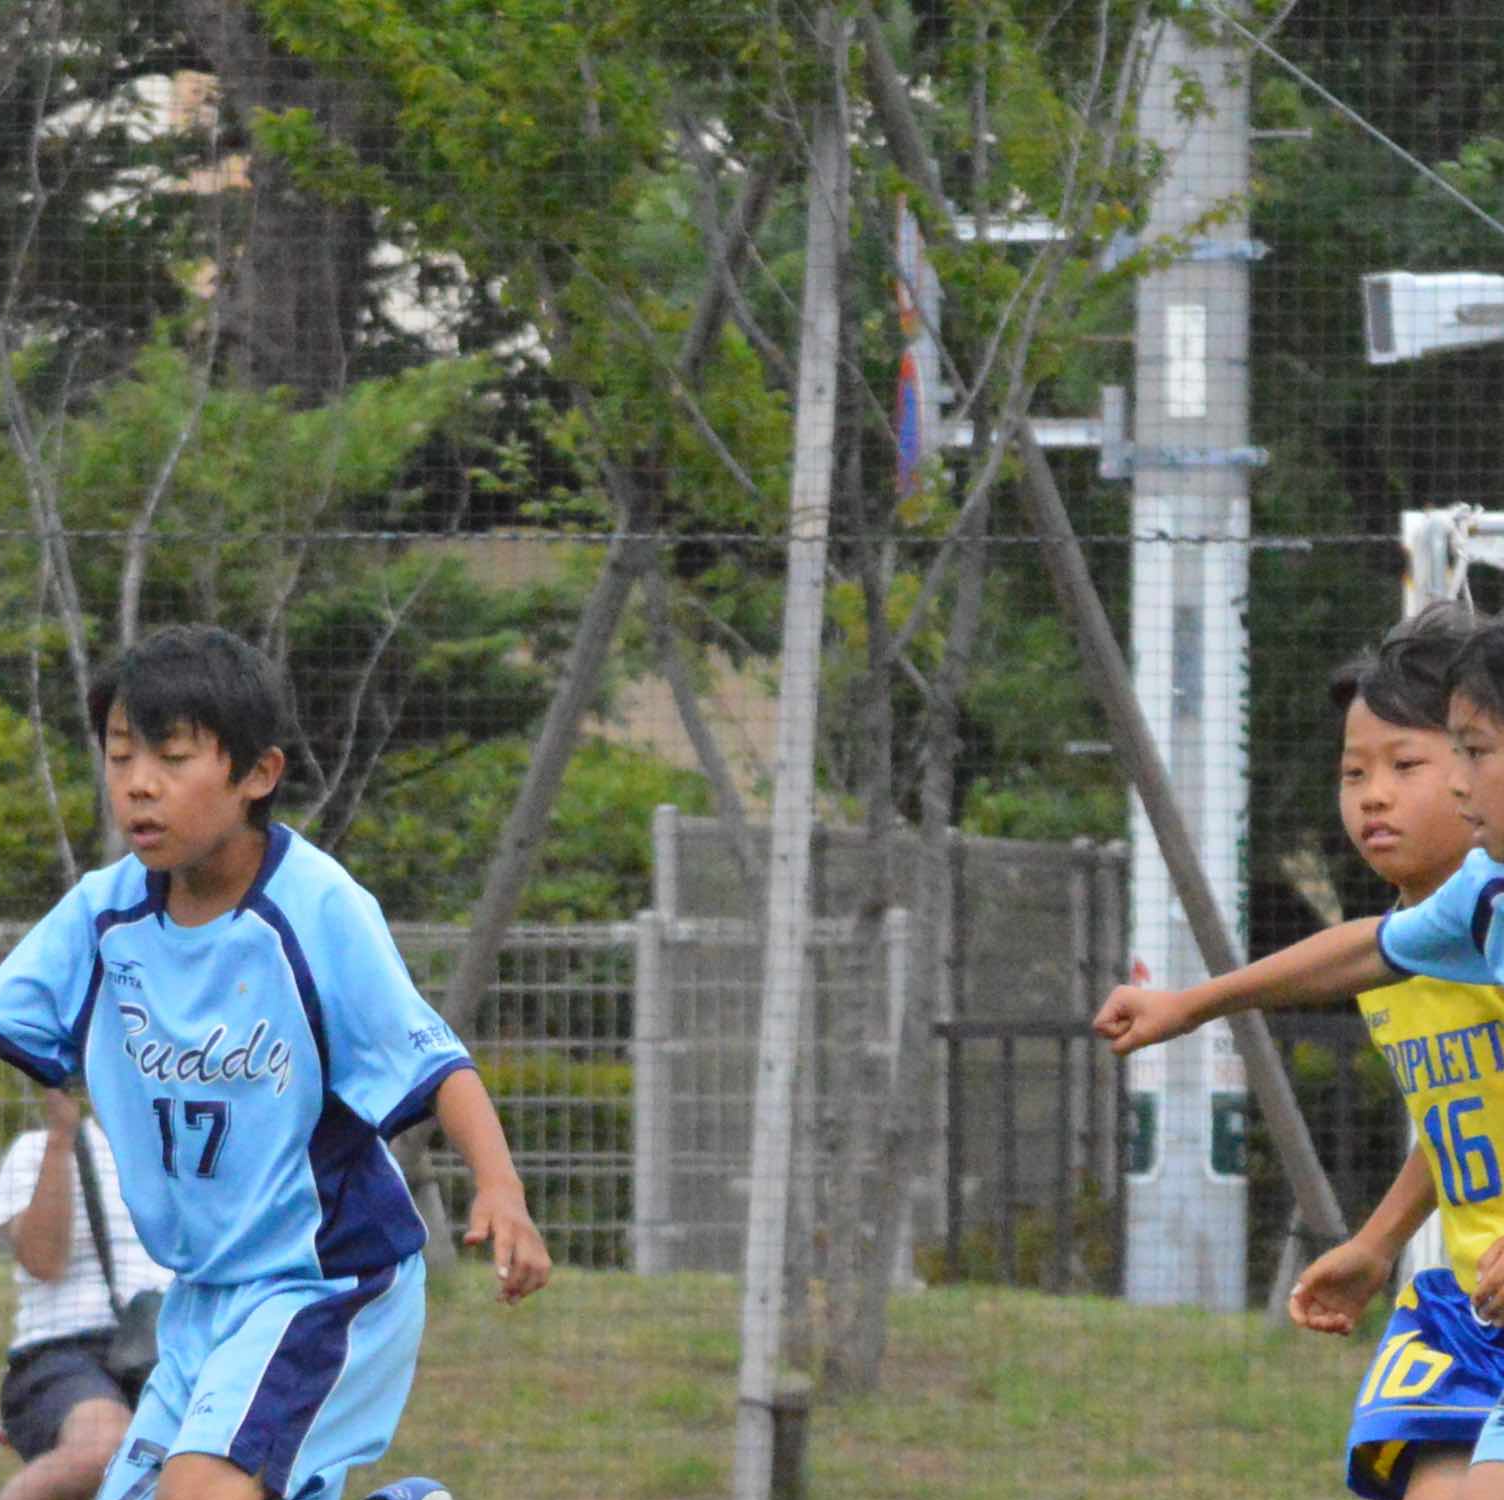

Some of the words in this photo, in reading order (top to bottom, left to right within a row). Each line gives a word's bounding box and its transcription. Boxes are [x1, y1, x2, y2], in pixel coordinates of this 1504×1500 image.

[152, 1097, 231, 1178] 17
[1423, 1096, 1503, 1207] 16
[1360, 1329, 1454, 1408] 16
